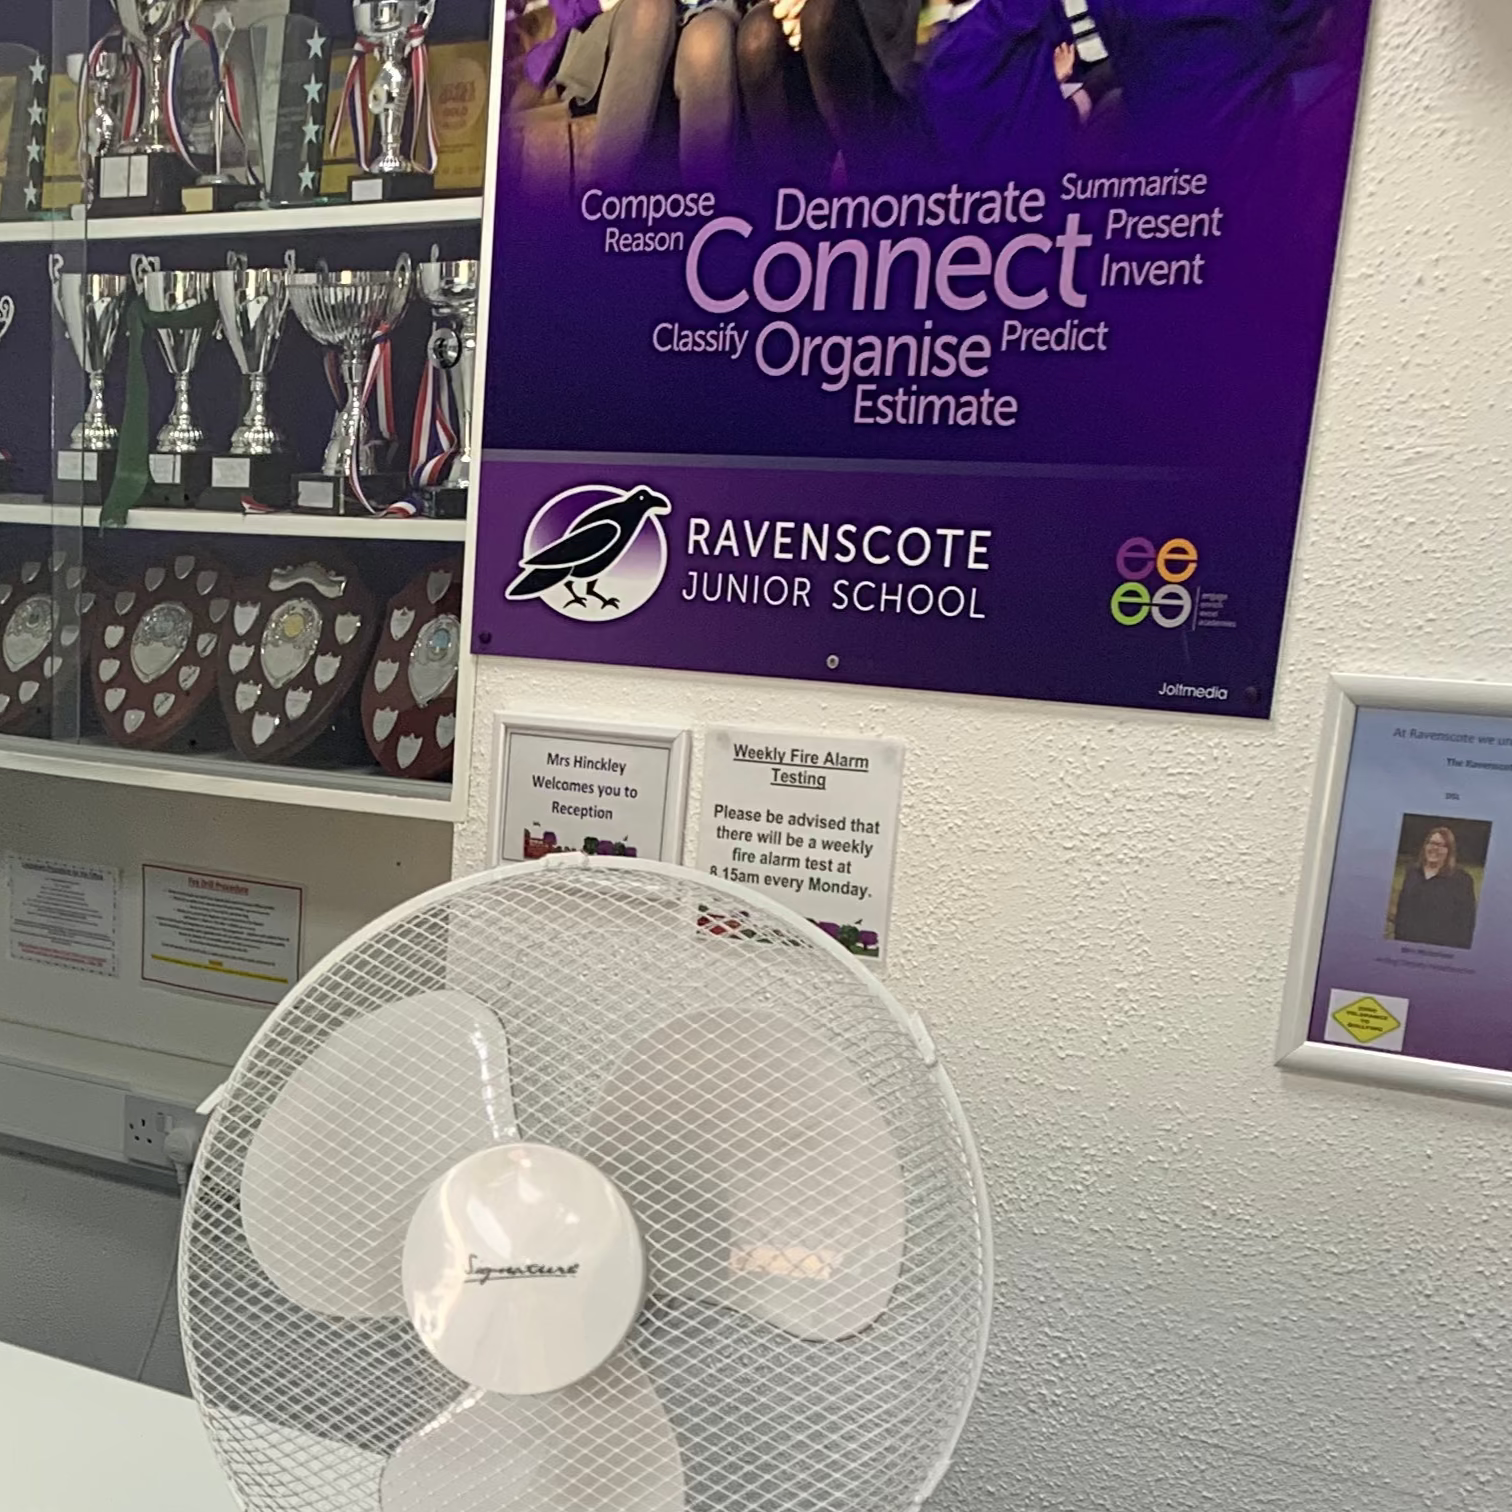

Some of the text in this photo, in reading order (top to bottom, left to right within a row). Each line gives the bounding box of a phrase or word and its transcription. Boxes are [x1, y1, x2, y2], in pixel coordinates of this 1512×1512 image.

[1060, 169, 1208, 201] Summarise
[580, 188, 716, 226] Compose
[775, 181, 1046, 230] Demonstrate
[1105, 207, 1223, 240] Present
[604, 226, 684, 254] Reason
[686, 213, 1093, 313] Connect
[1100, 253, 1205, 287] Invent
[652, 322, 749, 360] Classify
[1001, 320, 1109, 353] Predict
[755, 320, 991, 392] Organise
[853, 384, 1018, 427] Estimate
[688, 517, 992, 571] RAVENSCOTE
[681, 571, 986, 620] JUNIOR SCHOOL
[1158, 682, 1228, 700] Joltmedia
[1410, 728, 1474, 743] Ravenscote
[547, 752, 626, 776] Mrs Hinckley
[734, 744, 869, 768] Weekly Fire Alarm
[532, 774, 638, 799] Welcomes you to
[771, 767, 826, 788] Testing
[552, 801, 613, 820] Reception
[714, 804, 880, 835] Please be advised that
[716, 825, 873, 859] there will be a weekly
[732, 847, 852, 874] fire alarm test at
[764, 874, 804, 892] every
[808, 876, 872, 900] Monday.
